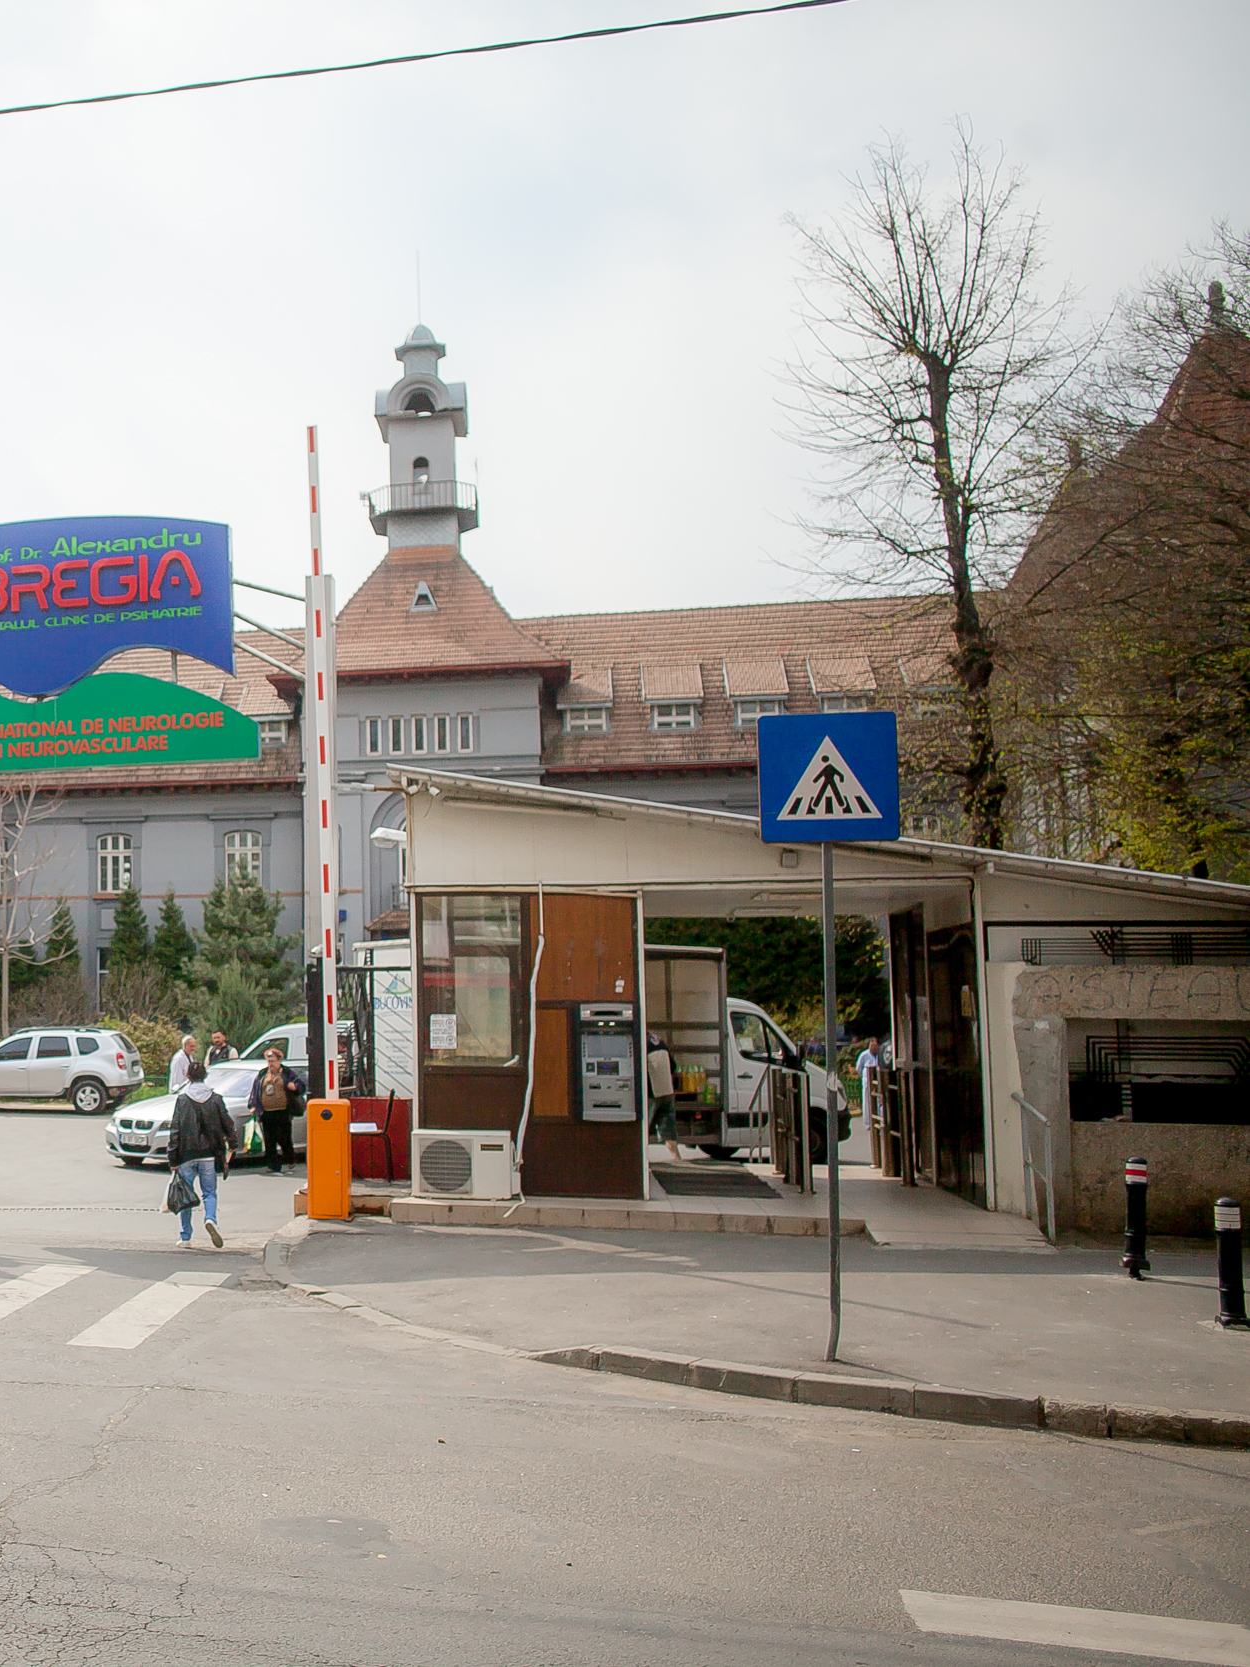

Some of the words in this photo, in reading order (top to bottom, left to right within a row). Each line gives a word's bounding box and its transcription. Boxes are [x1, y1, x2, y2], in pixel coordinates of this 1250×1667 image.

[20, 546, 43, 560] Dr.
[49, 527, 202, 557] Alexandru
[44, 614, 90, 627] CLINIC
[93, 612, 116, 624] DE
[120, 605, 203, 622] PSIHIATRIE
[81, 717, 104, 735] DE
[108, 711, 225, 733] NEUROLOGIE
[7, 734, 169, 758] NEUROVASCULARE
